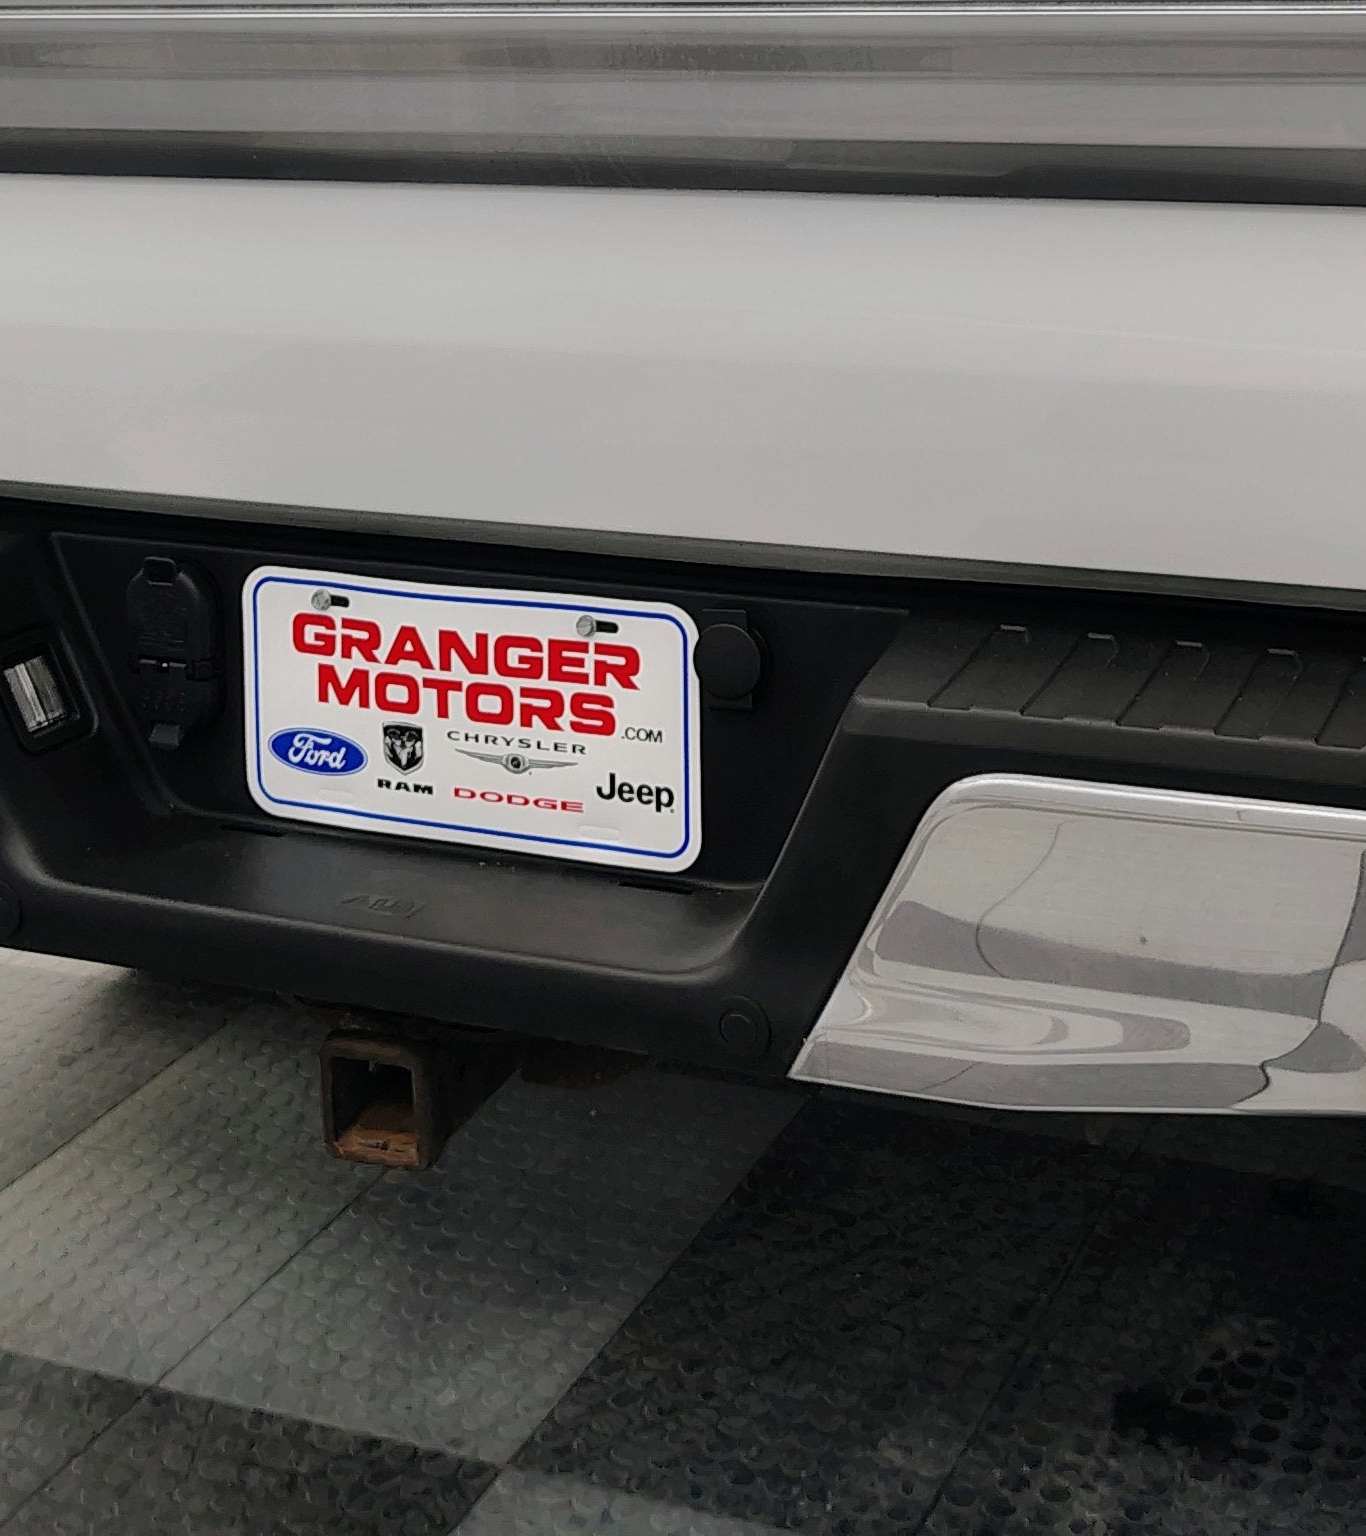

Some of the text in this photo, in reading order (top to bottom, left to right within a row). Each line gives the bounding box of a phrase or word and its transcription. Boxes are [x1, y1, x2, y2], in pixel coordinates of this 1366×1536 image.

[292, 612, 641, 691] GRANGER
[317, 663, 617, 737] MOTORS
[287, 732, 347, 770] Ford
[446, 729, 587, 756] CHRYSLER
[376, 778, 434, 795] RAM
[452, 786, 585, 814] DODGE
[596, 772, 675, 813] Jeep
